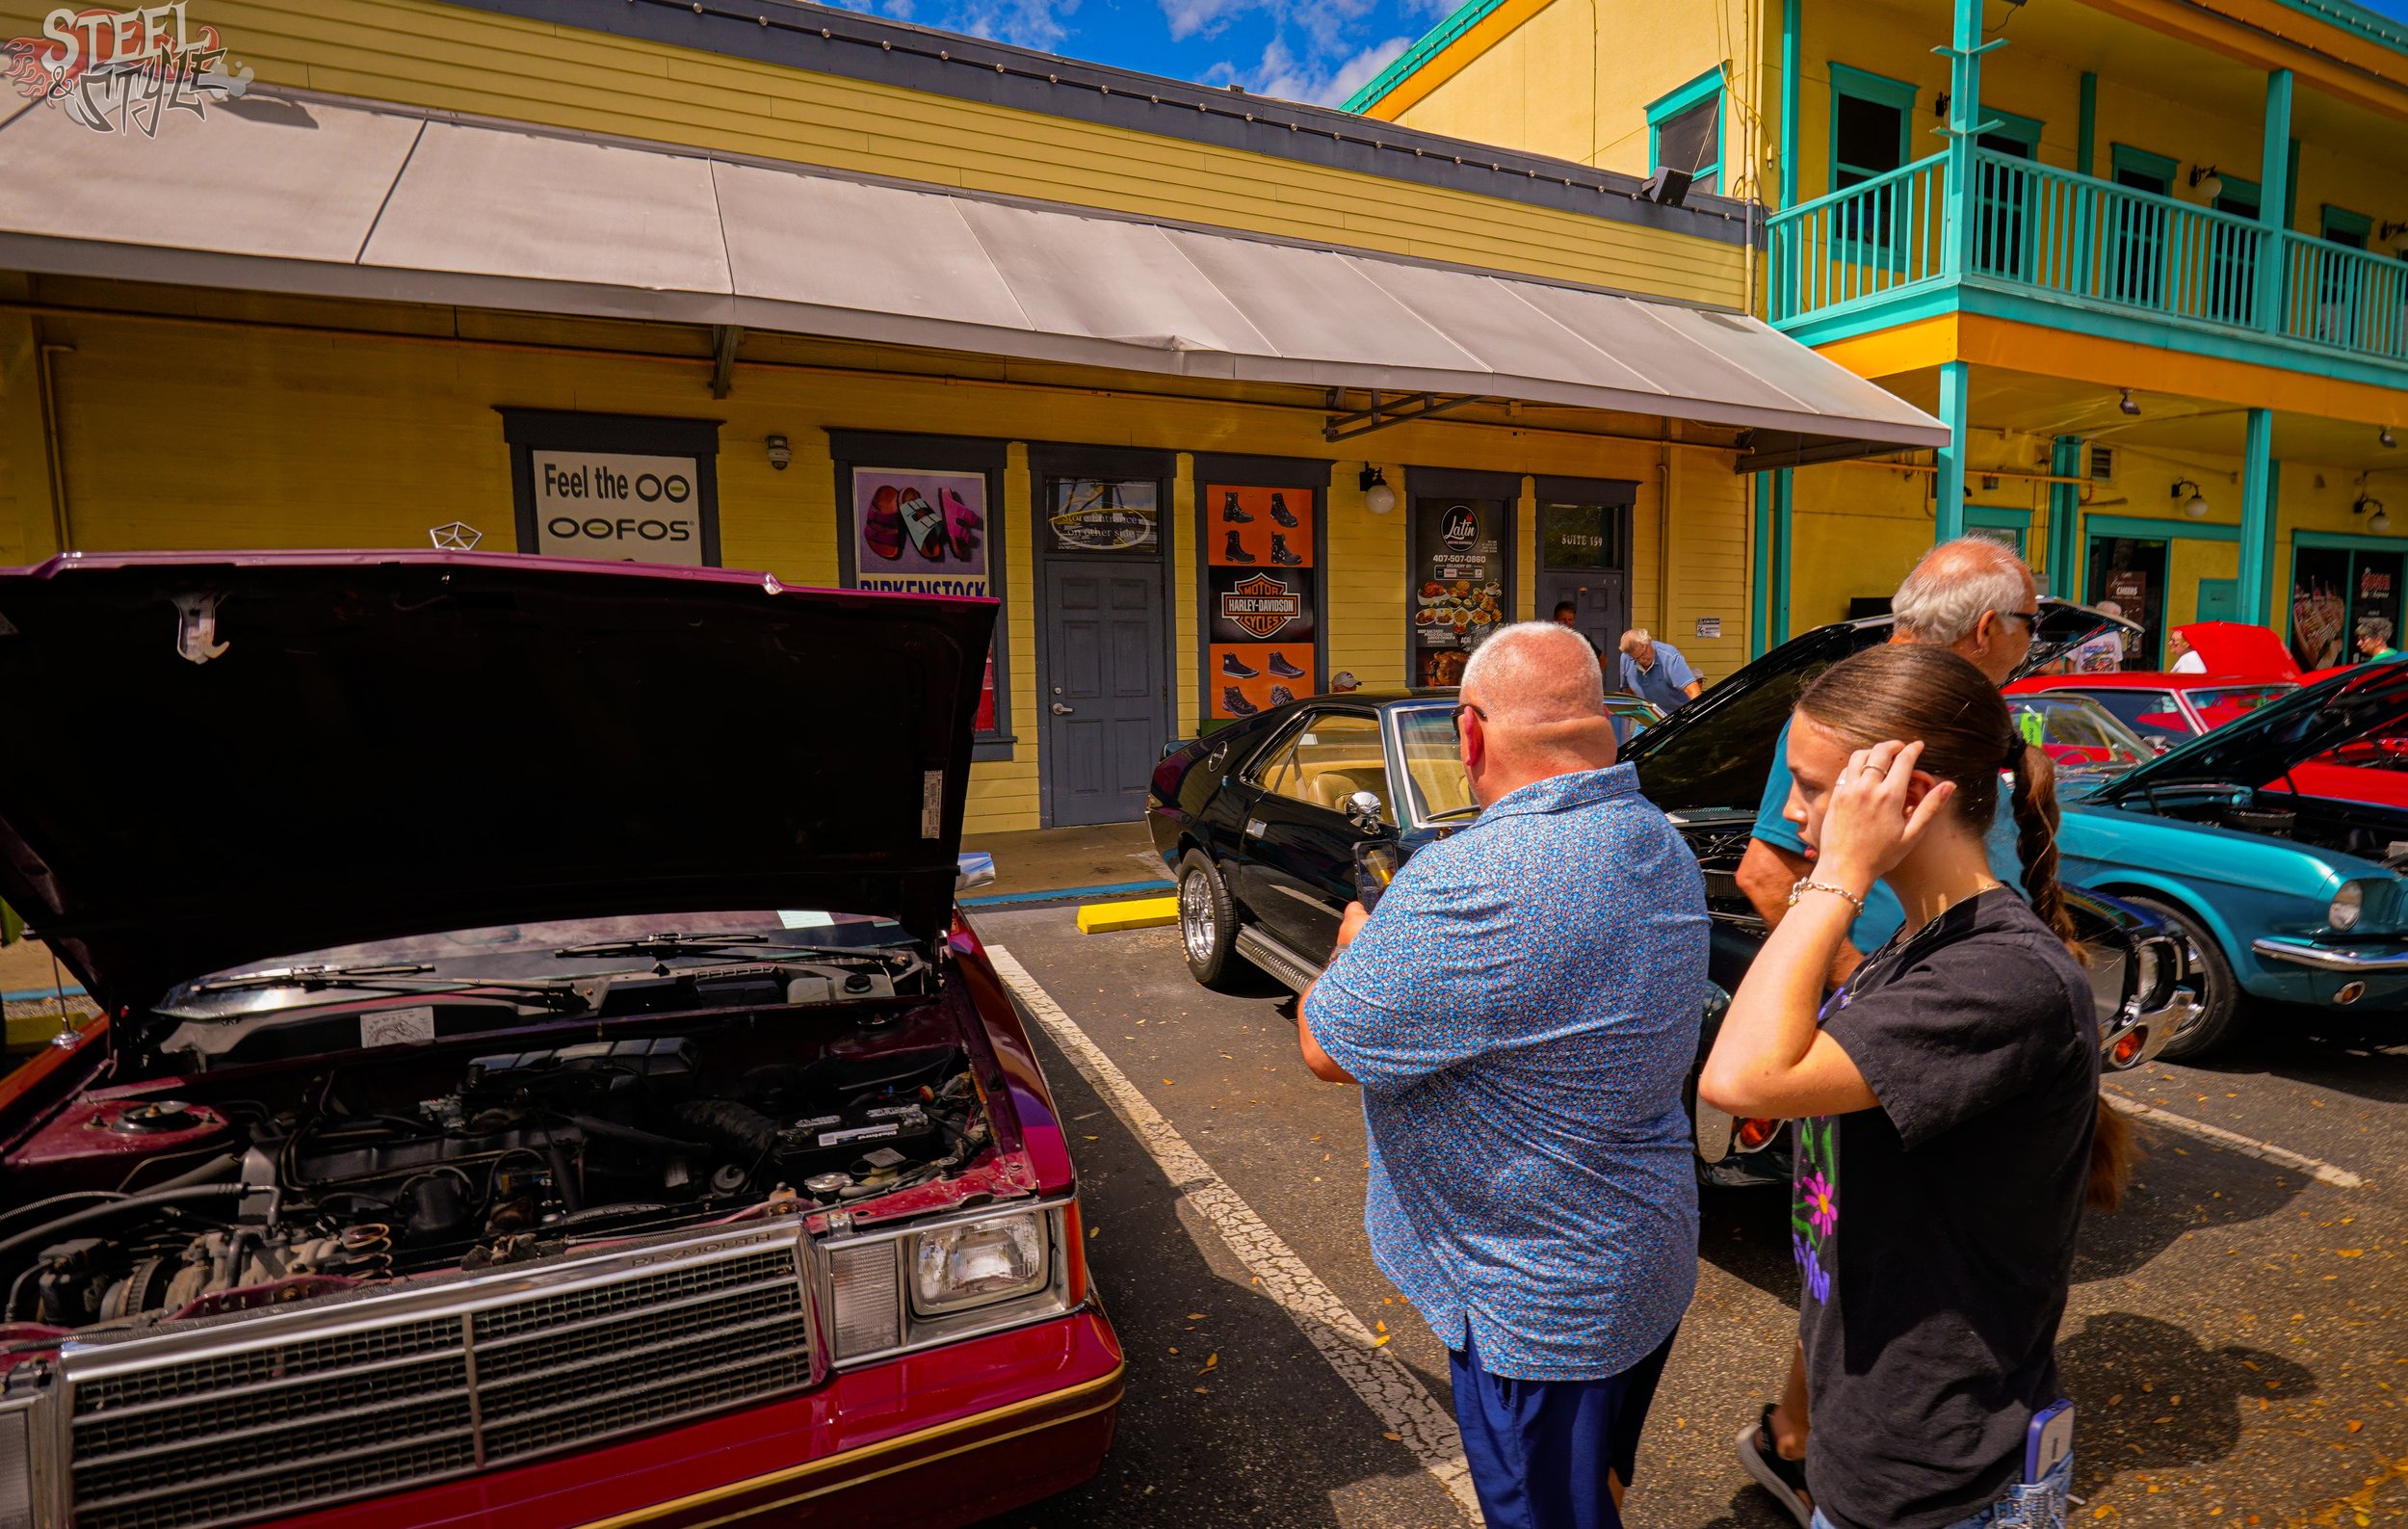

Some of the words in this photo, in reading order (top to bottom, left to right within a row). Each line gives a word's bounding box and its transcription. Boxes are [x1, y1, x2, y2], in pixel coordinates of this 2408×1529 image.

[544, 462, 589, 498] Feel
[594, 465, 629, 500] the
[635, 473, 691, 503] OO
[548, 517, 690, 541] OOFOS
[1085, 527, 1111, 537] other
[1114, 528, 1135, 538] side
[1444, 515, 1475, 540] Latin
[1561, 534, 1587, 545] SUITE
[1243, 581, 1278, 595] MOTOR
[1228, 599, 1294, 612] HARLEY-DAVIDSON
[1243, 615, 1279, 632] CYCLES
[632, 1233, 771, 1267] PLYMOUTH
